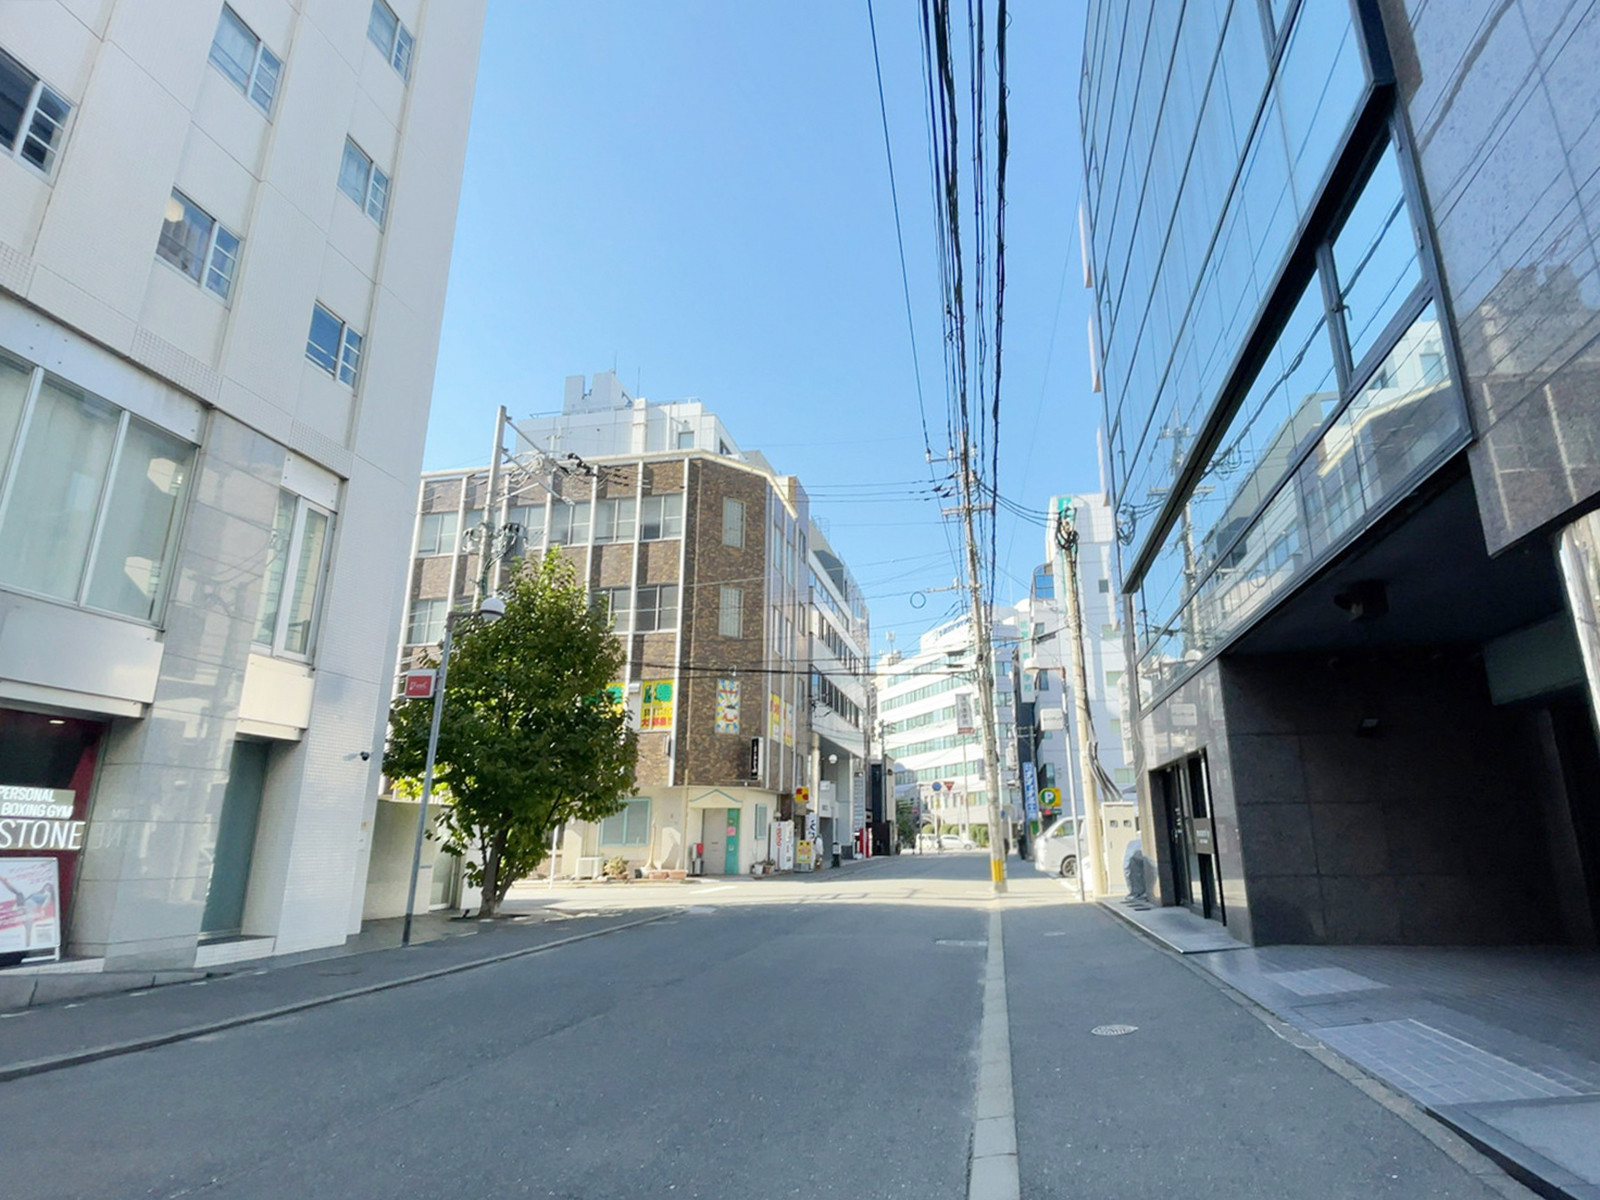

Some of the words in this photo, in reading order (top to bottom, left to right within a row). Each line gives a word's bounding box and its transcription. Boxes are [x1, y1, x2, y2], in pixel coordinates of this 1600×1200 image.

[0, 785, 56, 803] PERSONAL
[1043, 791, 1055, 804] P
[1, 802, 47, 817] BOXING
[47, 804, 74, 820] GYM
[0, 819, 86, 849] STONE
